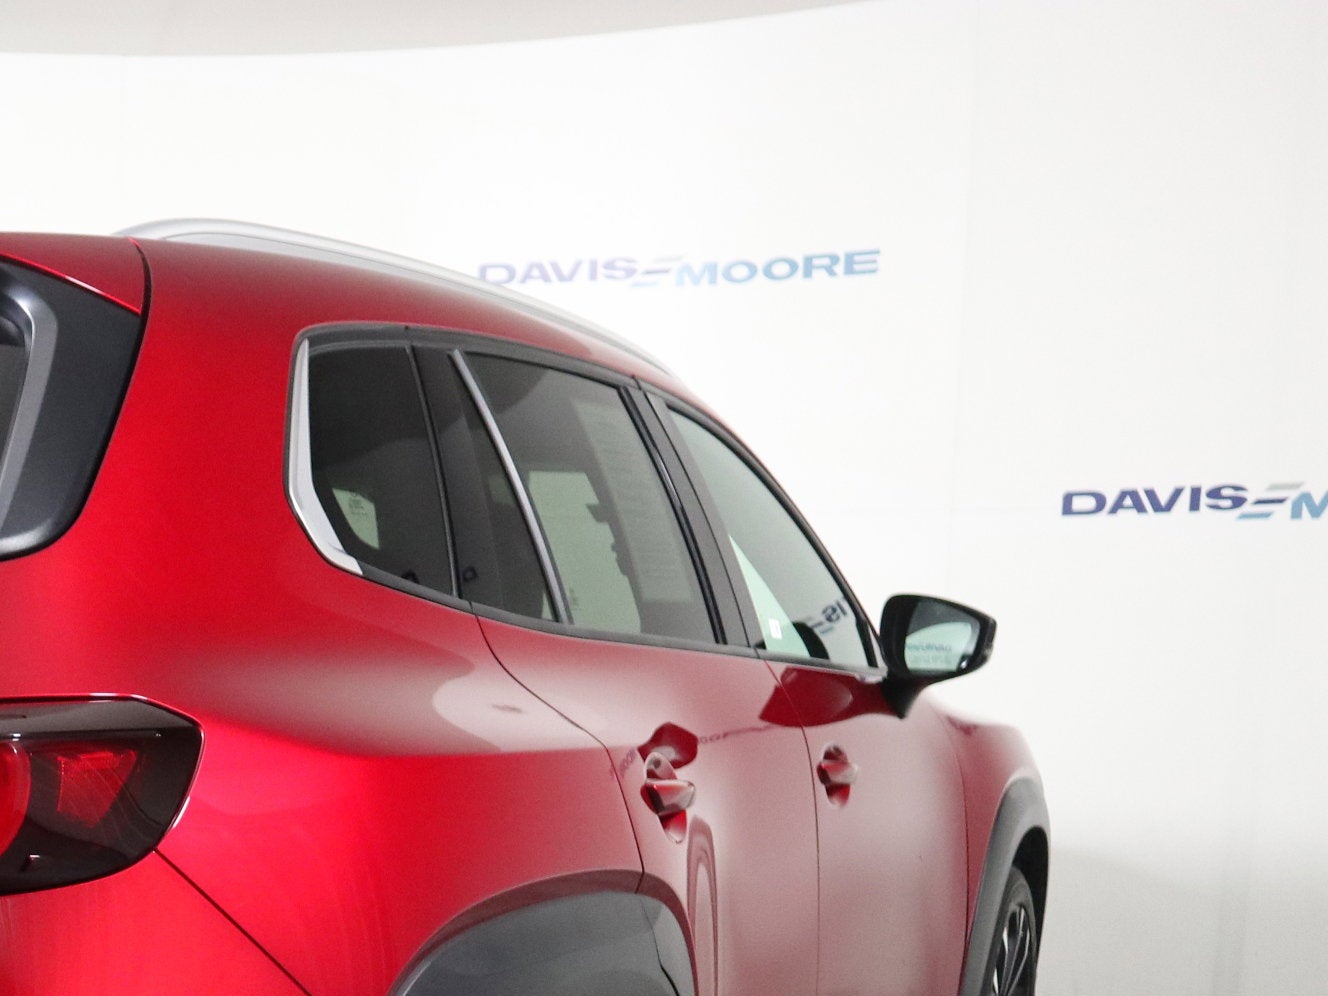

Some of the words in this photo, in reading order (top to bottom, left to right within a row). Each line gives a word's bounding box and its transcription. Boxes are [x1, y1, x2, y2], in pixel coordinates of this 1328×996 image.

[477, 256, 638, 286] DAVIS
[675, 248, 881, 287] MOORE
[1061, 484, 1249, 516] DAVIS
